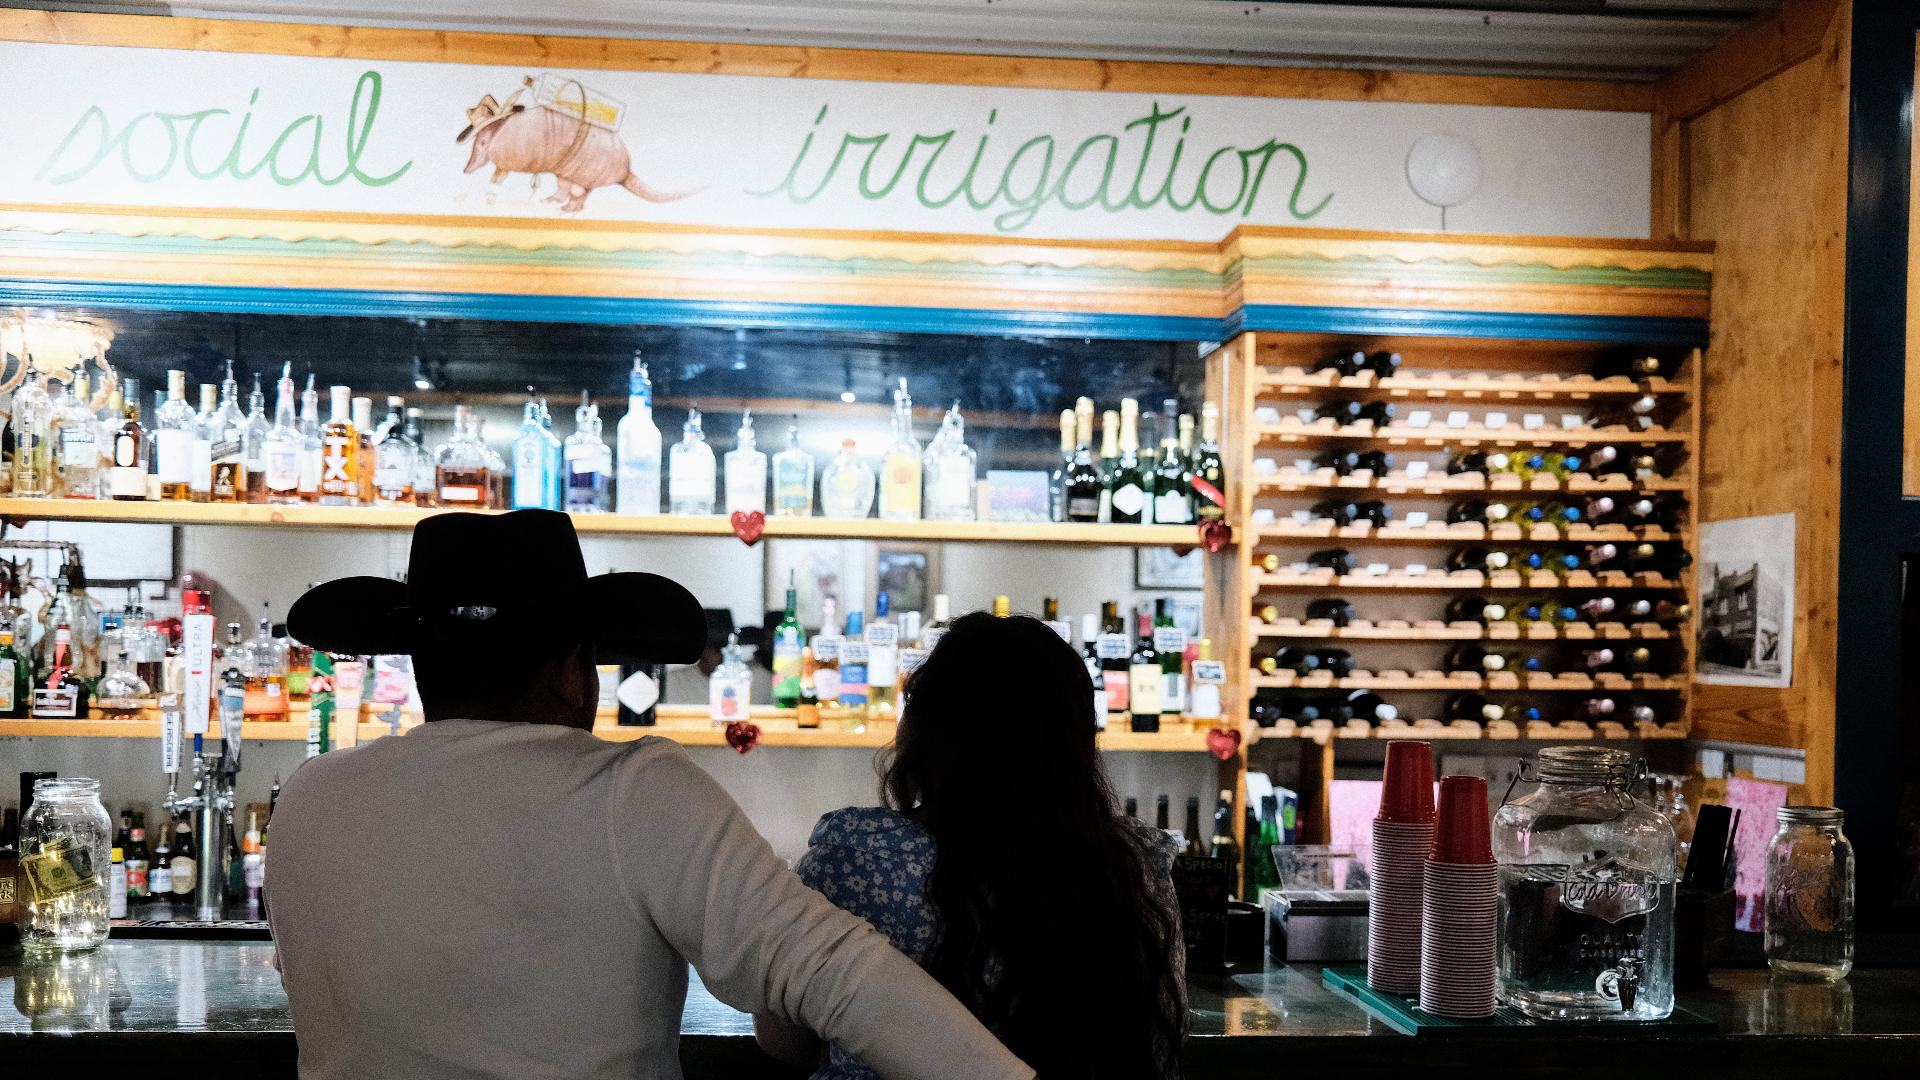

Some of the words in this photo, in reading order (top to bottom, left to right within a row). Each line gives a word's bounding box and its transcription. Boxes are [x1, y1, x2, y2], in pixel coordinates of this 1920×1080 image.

[33, 70, 413, 186] social
[743, 102, 1335, 231] irrigation
[193, 623, 203, 667] ULTRA
[1580, 933, 1645, 946] QUALITY
